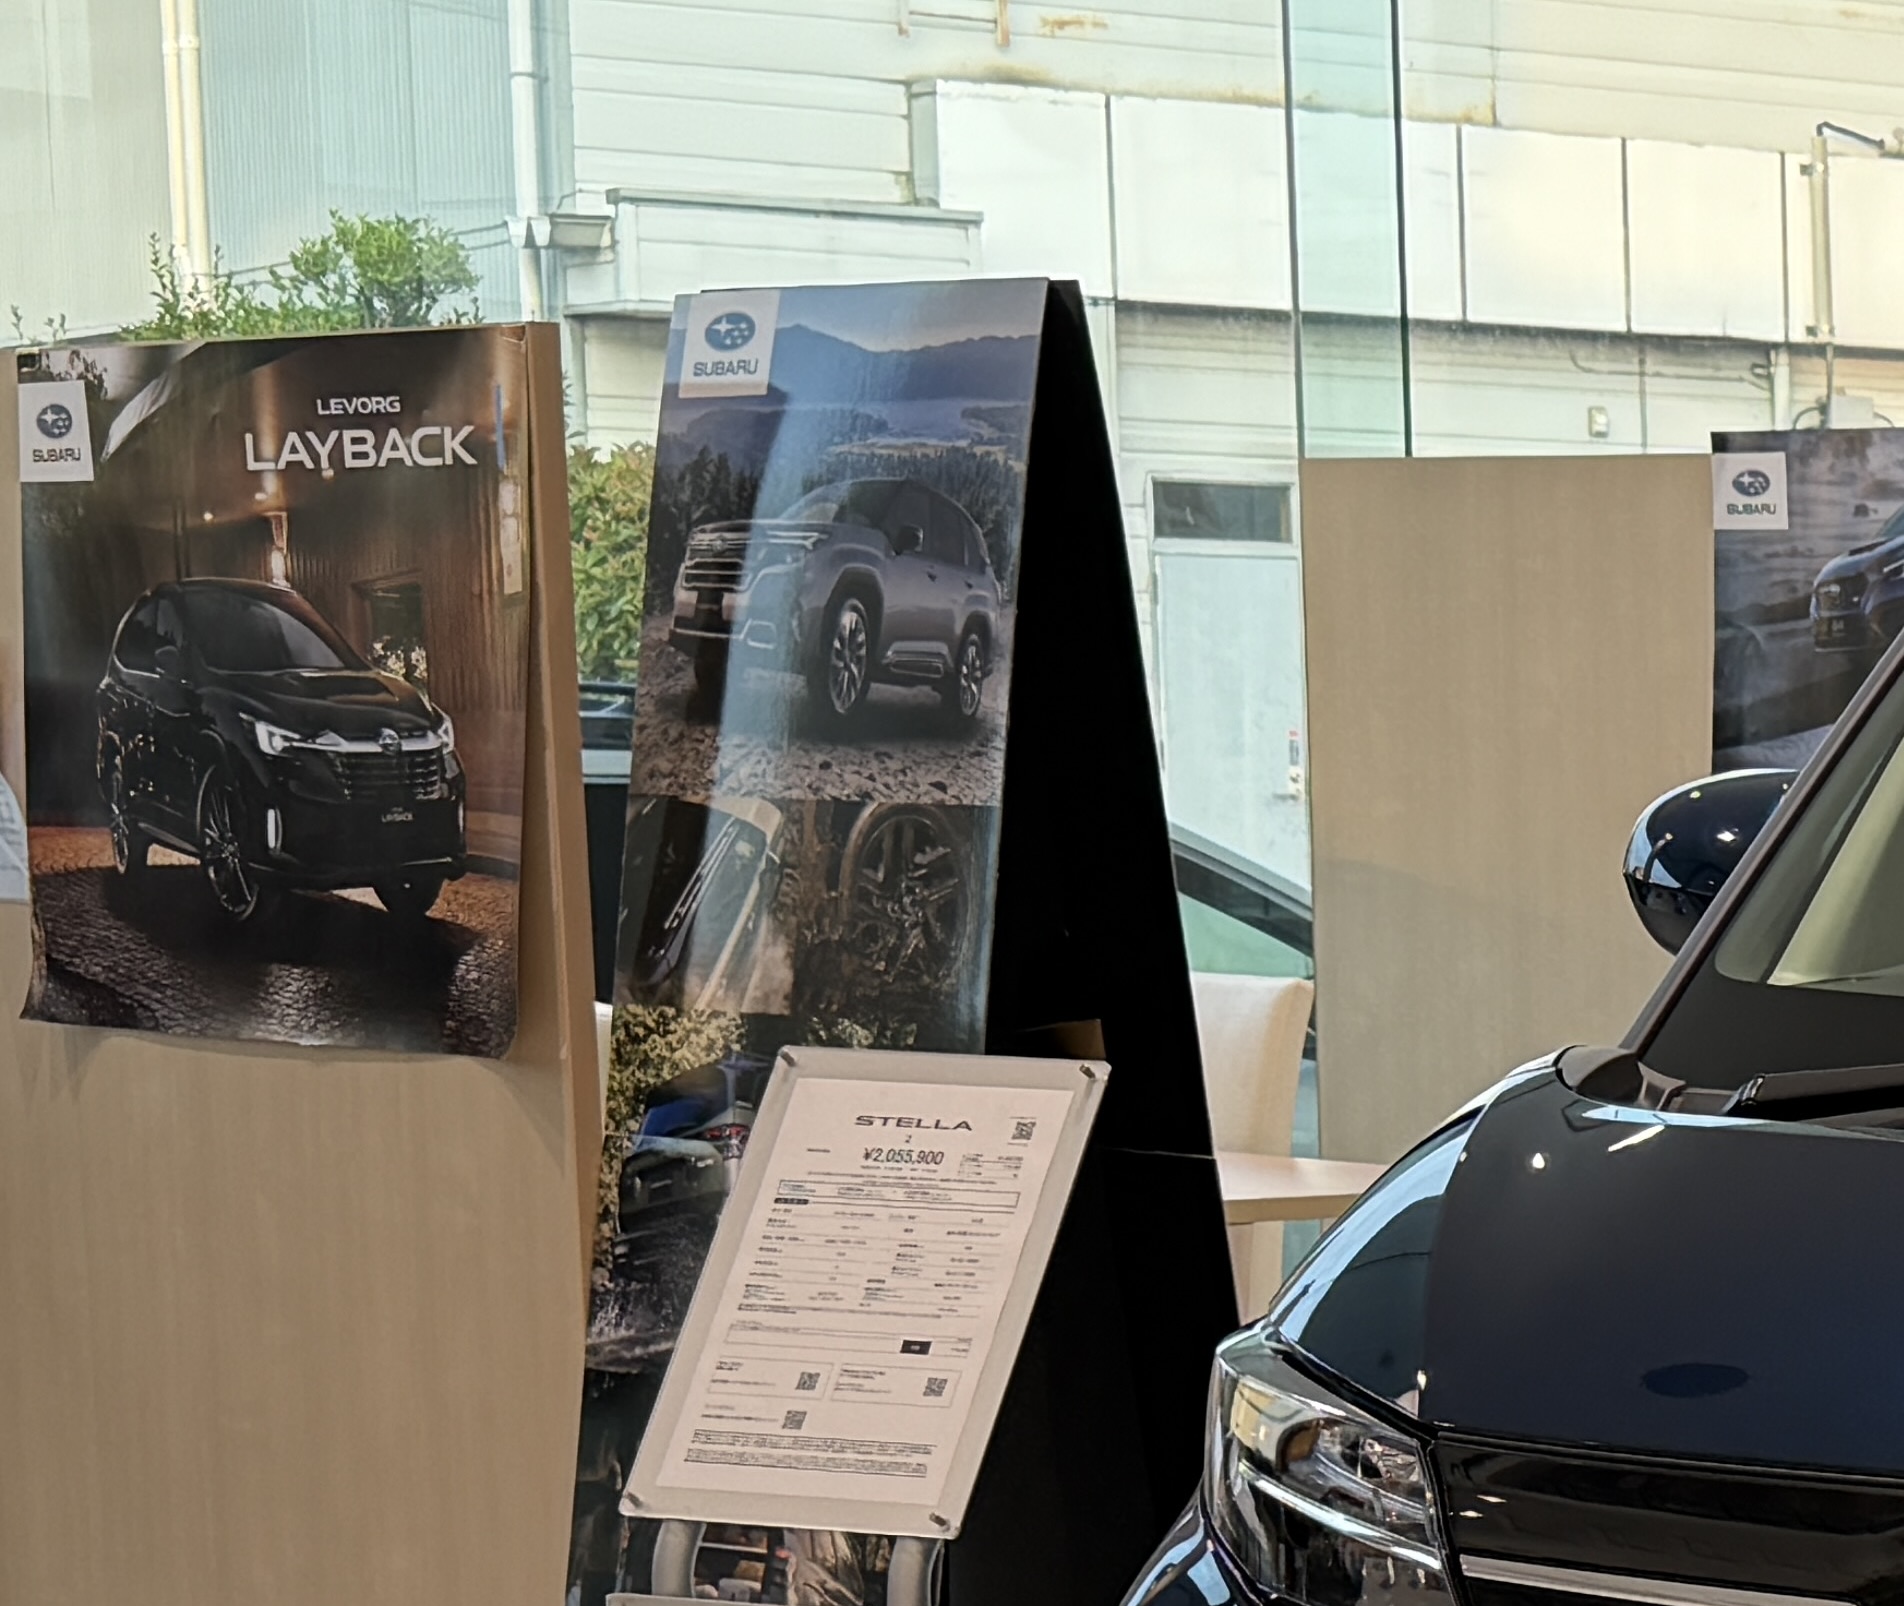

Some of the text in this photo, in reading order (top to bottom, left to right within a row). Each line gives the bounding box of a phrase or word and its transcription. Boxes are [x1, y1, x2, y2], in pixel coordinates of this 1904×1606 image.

[693, 356, 759, 379] SUBARU
[316, 396, 401, 416] LEVORG
[32, 446, 82, 463] SUBARU
[244, 425, 478, 472] LAYBACK
[1726, 502, 1777, 516] SUBARU
[855, 1115, 973, 1132] STELLA
